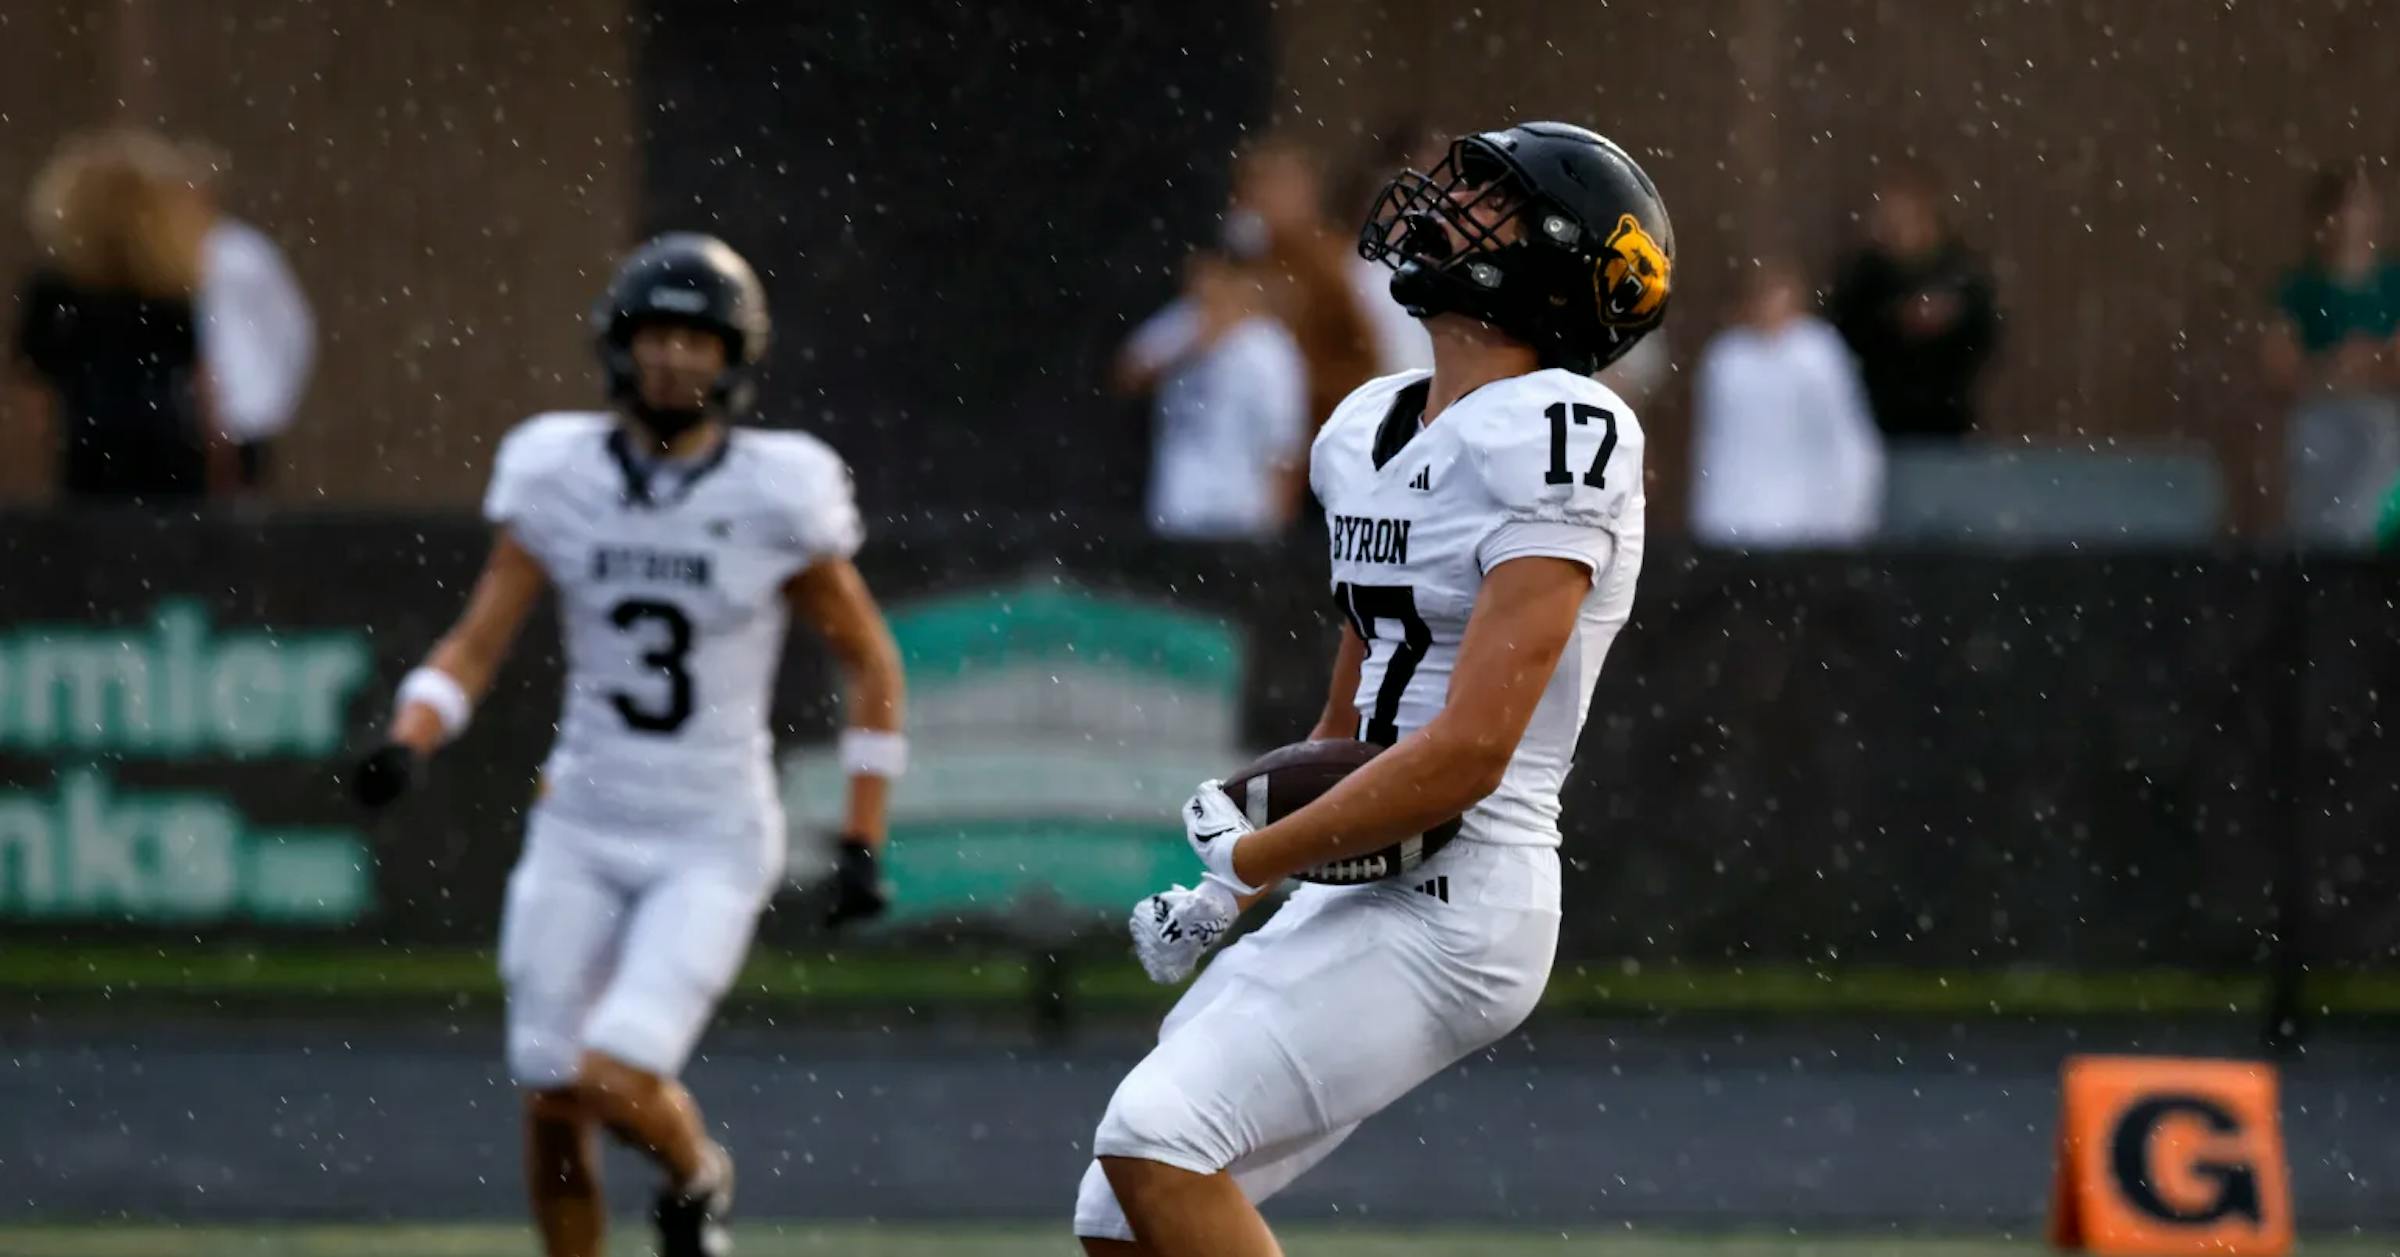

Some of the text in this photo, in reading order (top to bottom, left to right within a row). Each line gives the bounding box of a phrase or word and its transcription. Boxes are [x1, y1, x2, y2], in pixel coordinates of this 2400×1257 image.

[1543, 401, 1618, 490] 17
[1333, 514, 1412, 565] BYRON
[606, 597, 696, 739] 3
[2110, 1094, 2262, 1226] G
